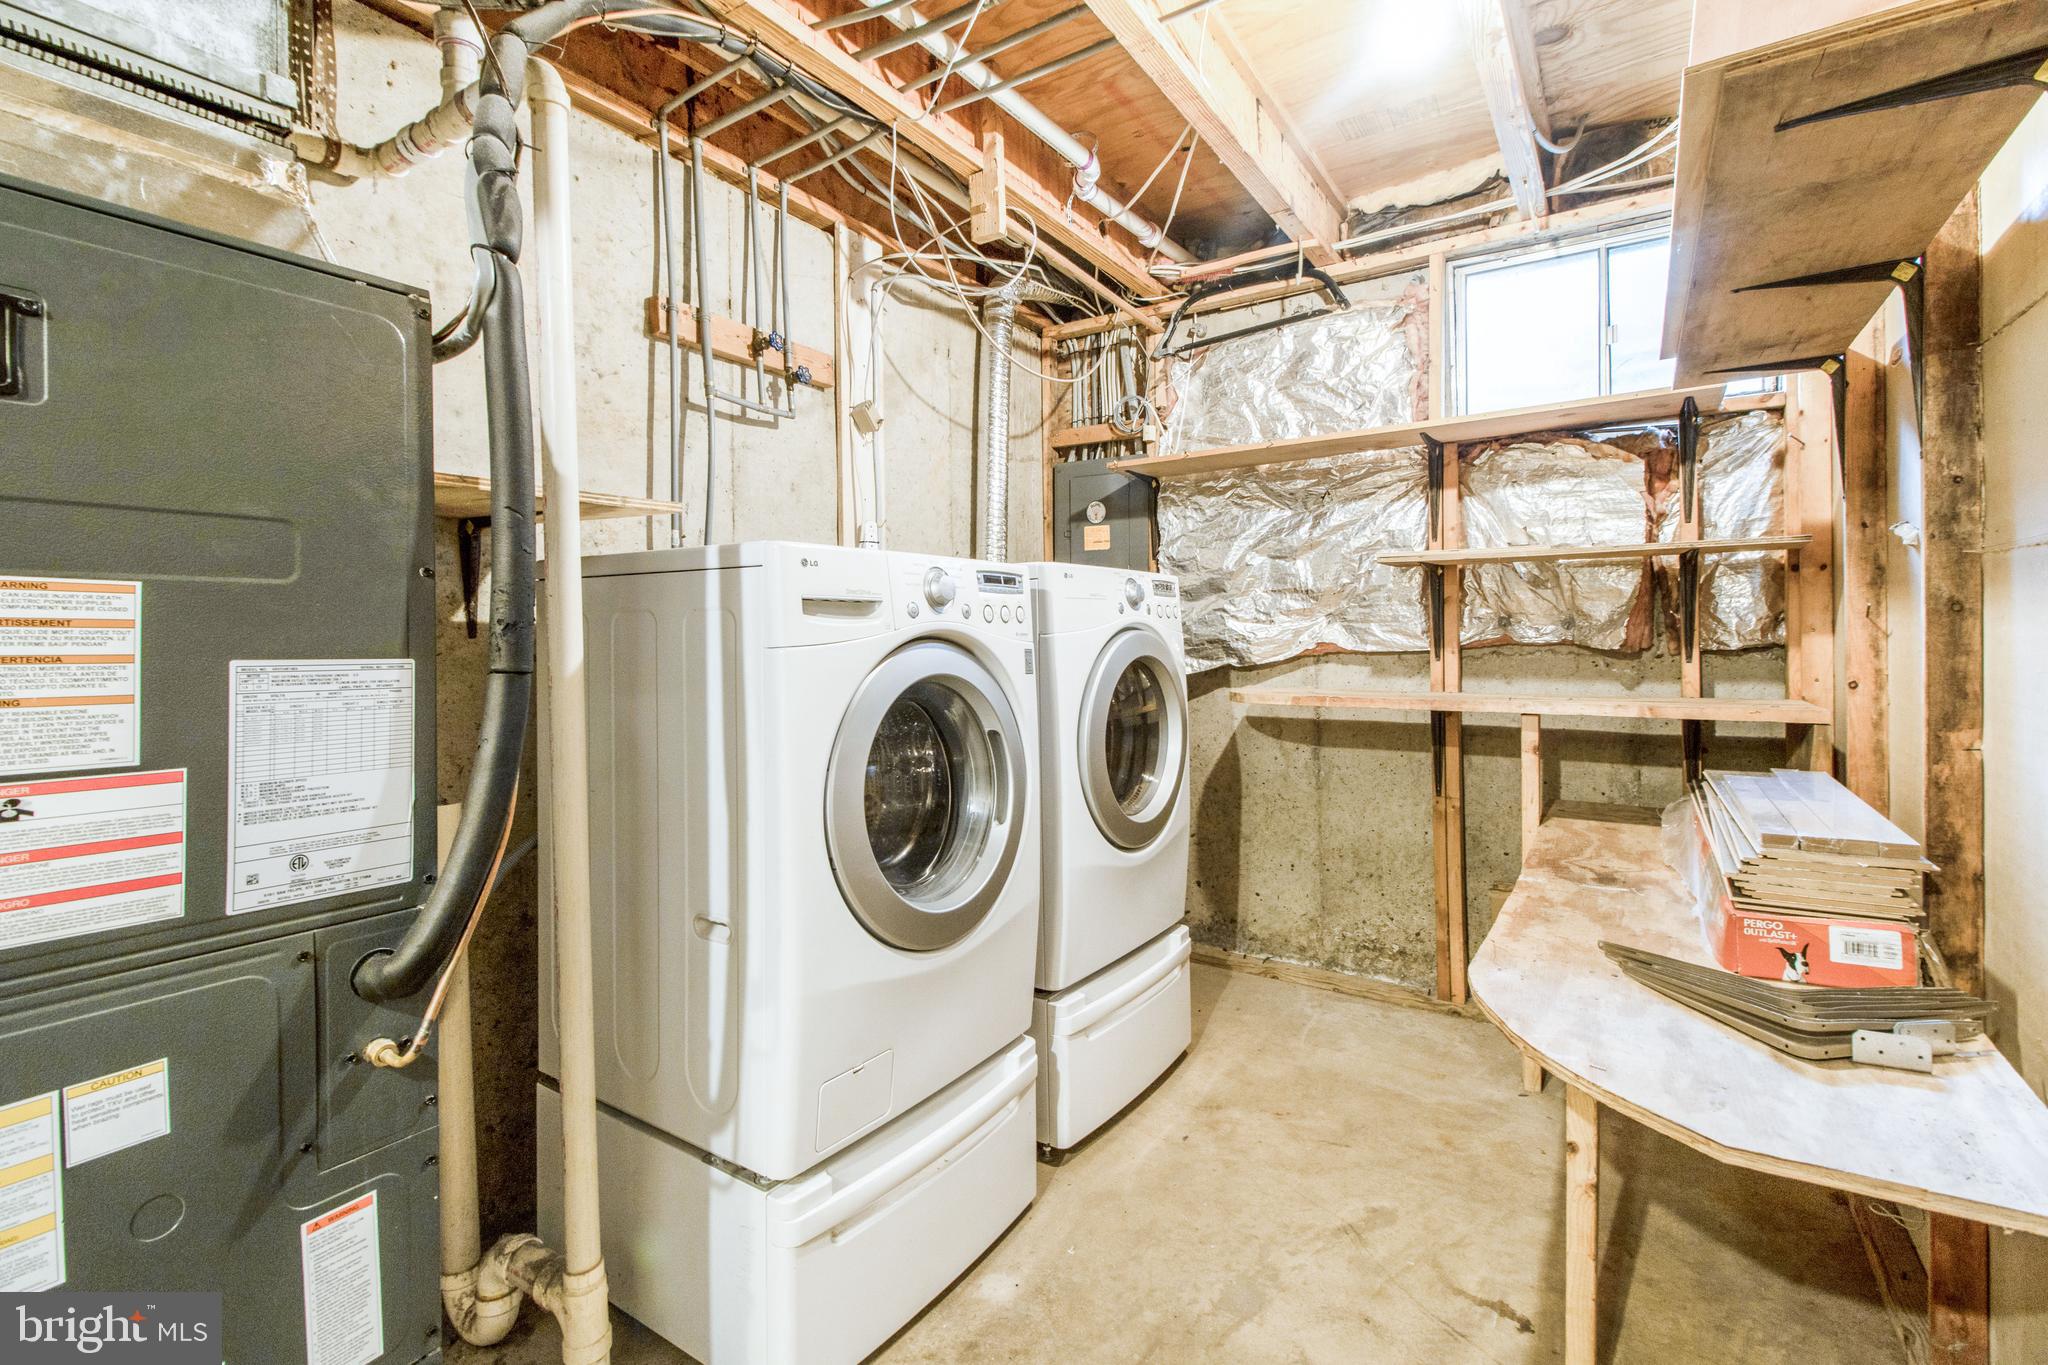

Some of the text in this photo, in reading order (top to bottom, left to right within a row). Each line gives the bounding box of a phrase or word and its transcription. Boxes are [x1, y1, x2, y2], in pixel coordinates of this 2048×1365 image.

[1, 581, 48, 590] ARNING
[1743, 918, 1783, 930] PERGO
[1744, 928, 1797, 940] OUTLAST+
[90, 1070, 143, 1090] CAUTION
[135, 1084, 152, 1092] used
